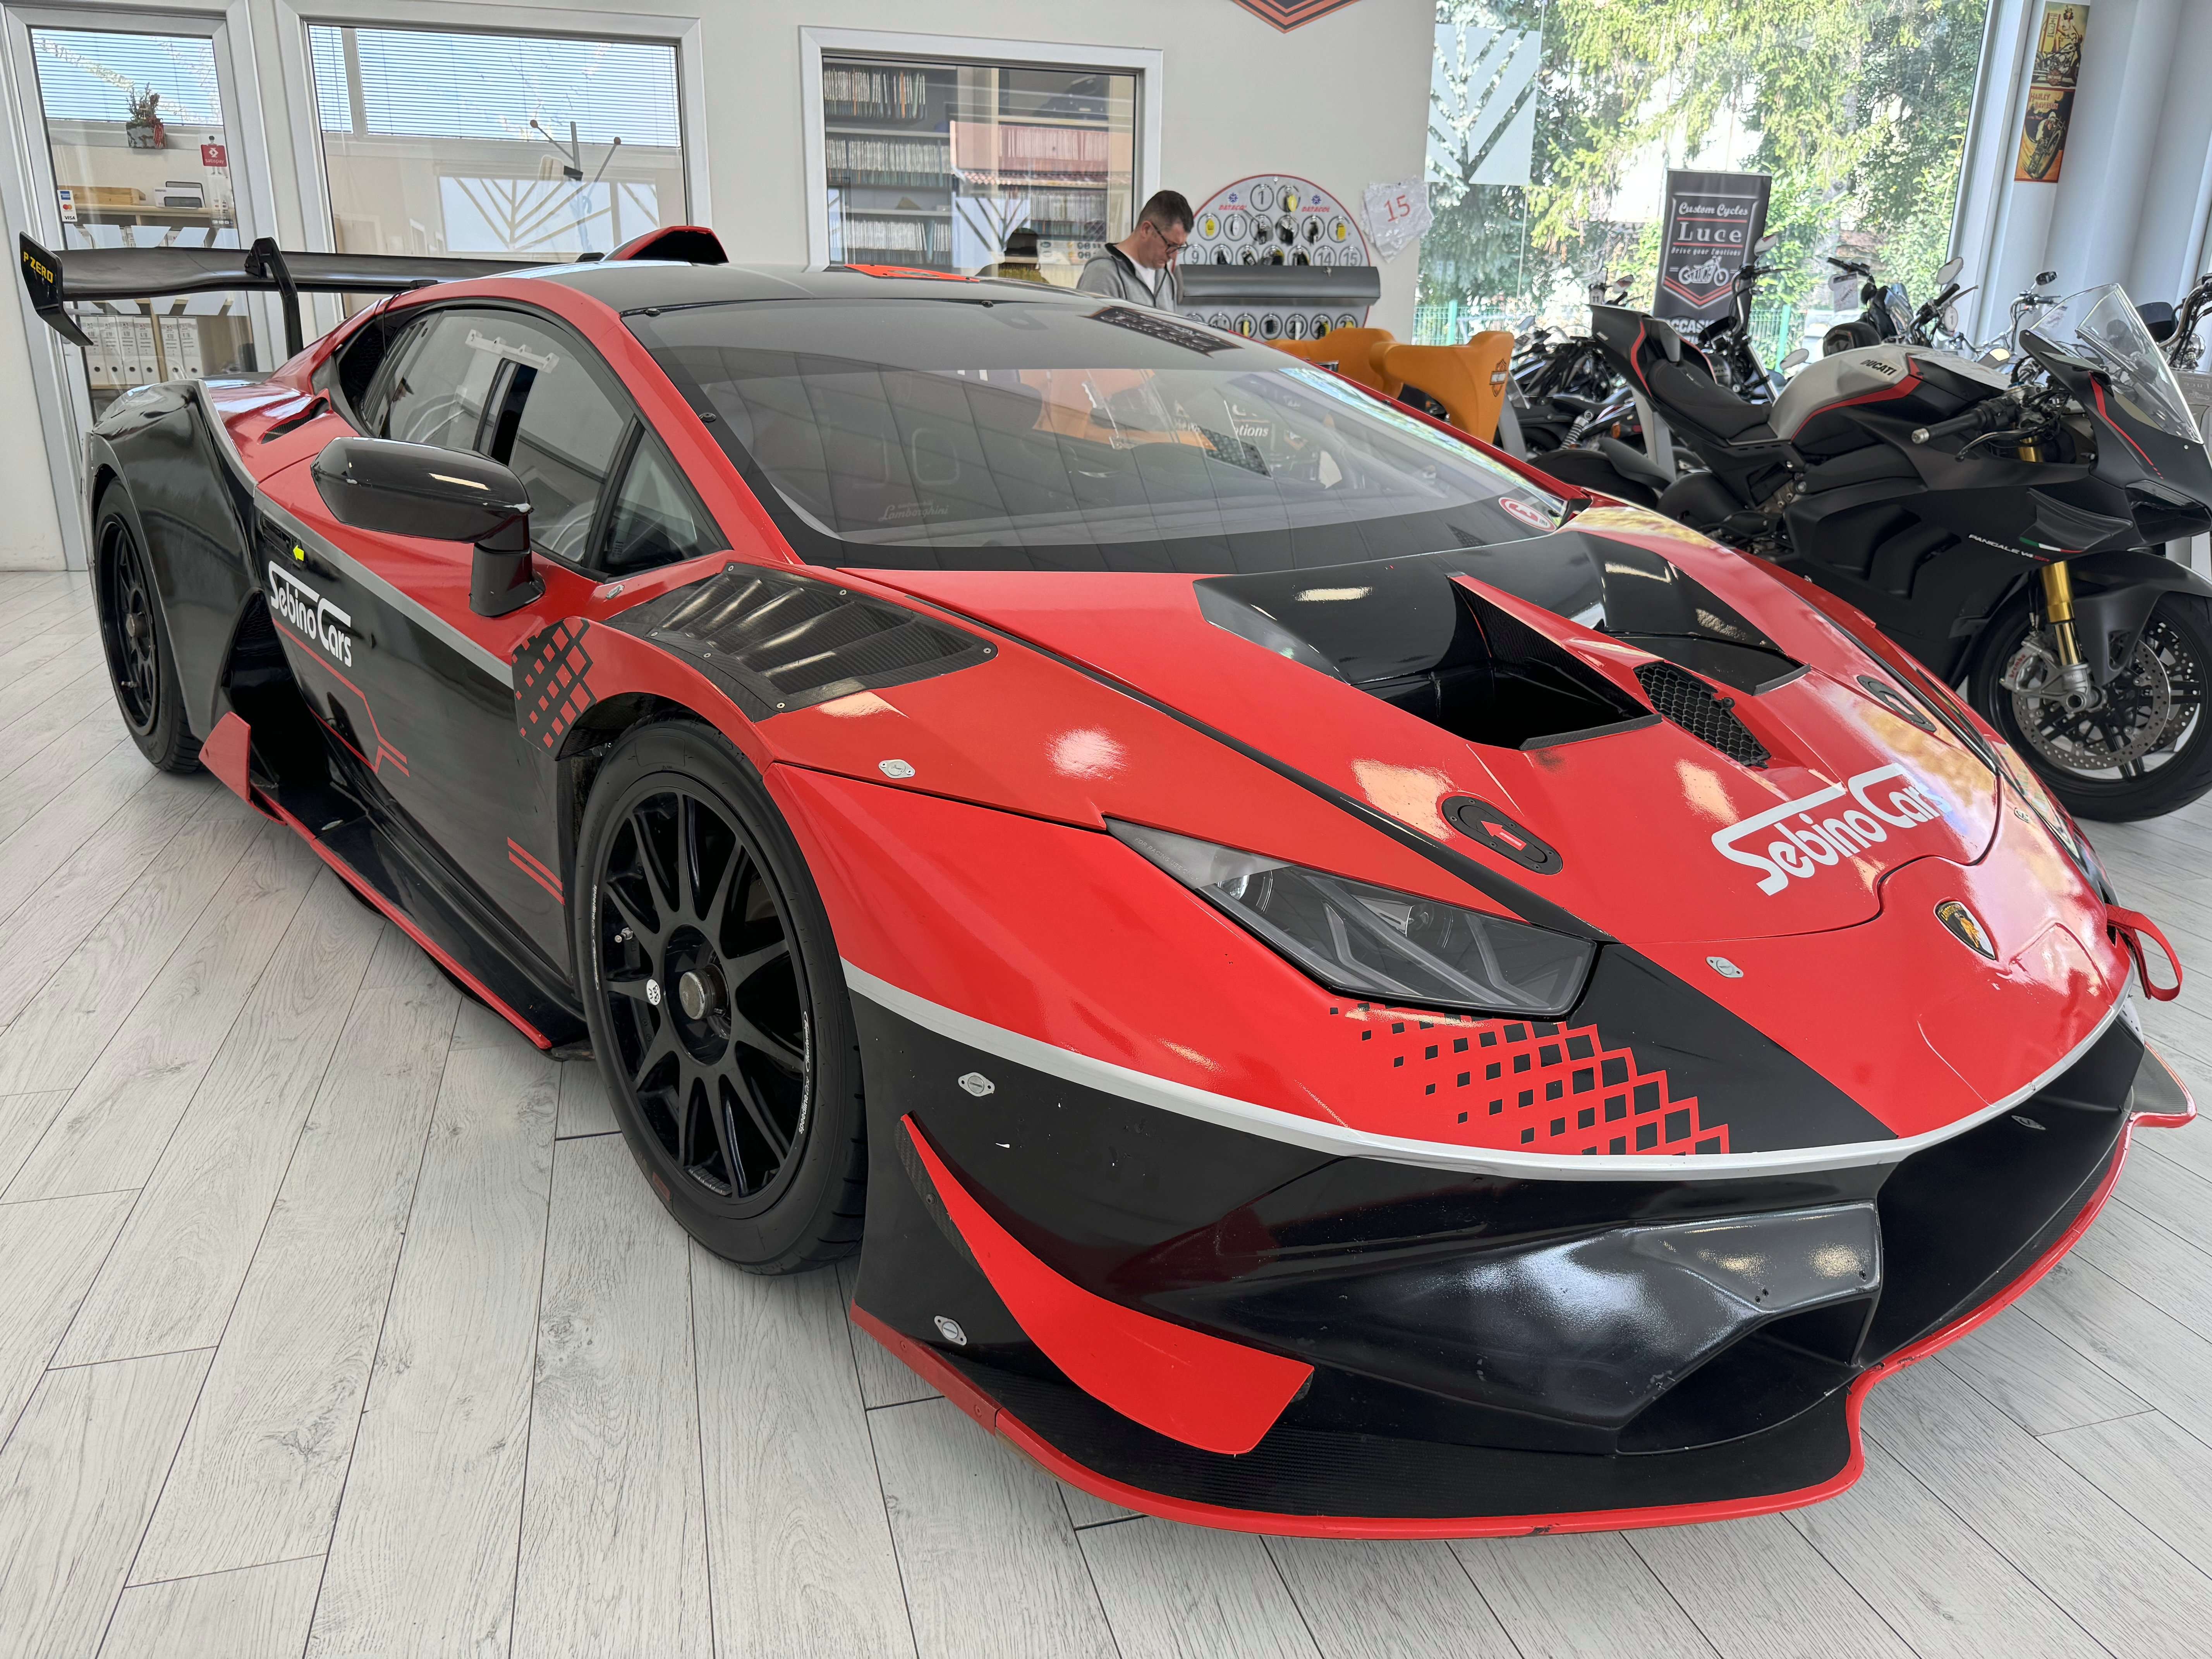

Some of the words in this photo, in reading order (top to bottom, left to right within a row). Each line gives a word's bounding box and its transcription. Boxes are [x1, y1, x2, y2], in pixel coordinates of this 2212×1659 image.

[1384, 194, 1411, 222] 15
[1678, 201, 1715, 215] Custom
[1716, 203, 1748, 217] Cycles
[1677, 221, 1742, 243] Luce
[1192, 250, 1199, 264] 9
[1671, 246, 1692, 254] Drive
[1317, 252, 1332, 266] 14
[1343, 252, 1358, 266] 15
[24, 251, 29, 262] P
[29, 256, 54, 284] ZERO
[1860, 359, 1897, 376] DUCATI
[878, 505, 949, 521] Lamborghini
[1968, 534, 2020, 554] PANIGALE
[2008, 654, 2026, 678] brembo
